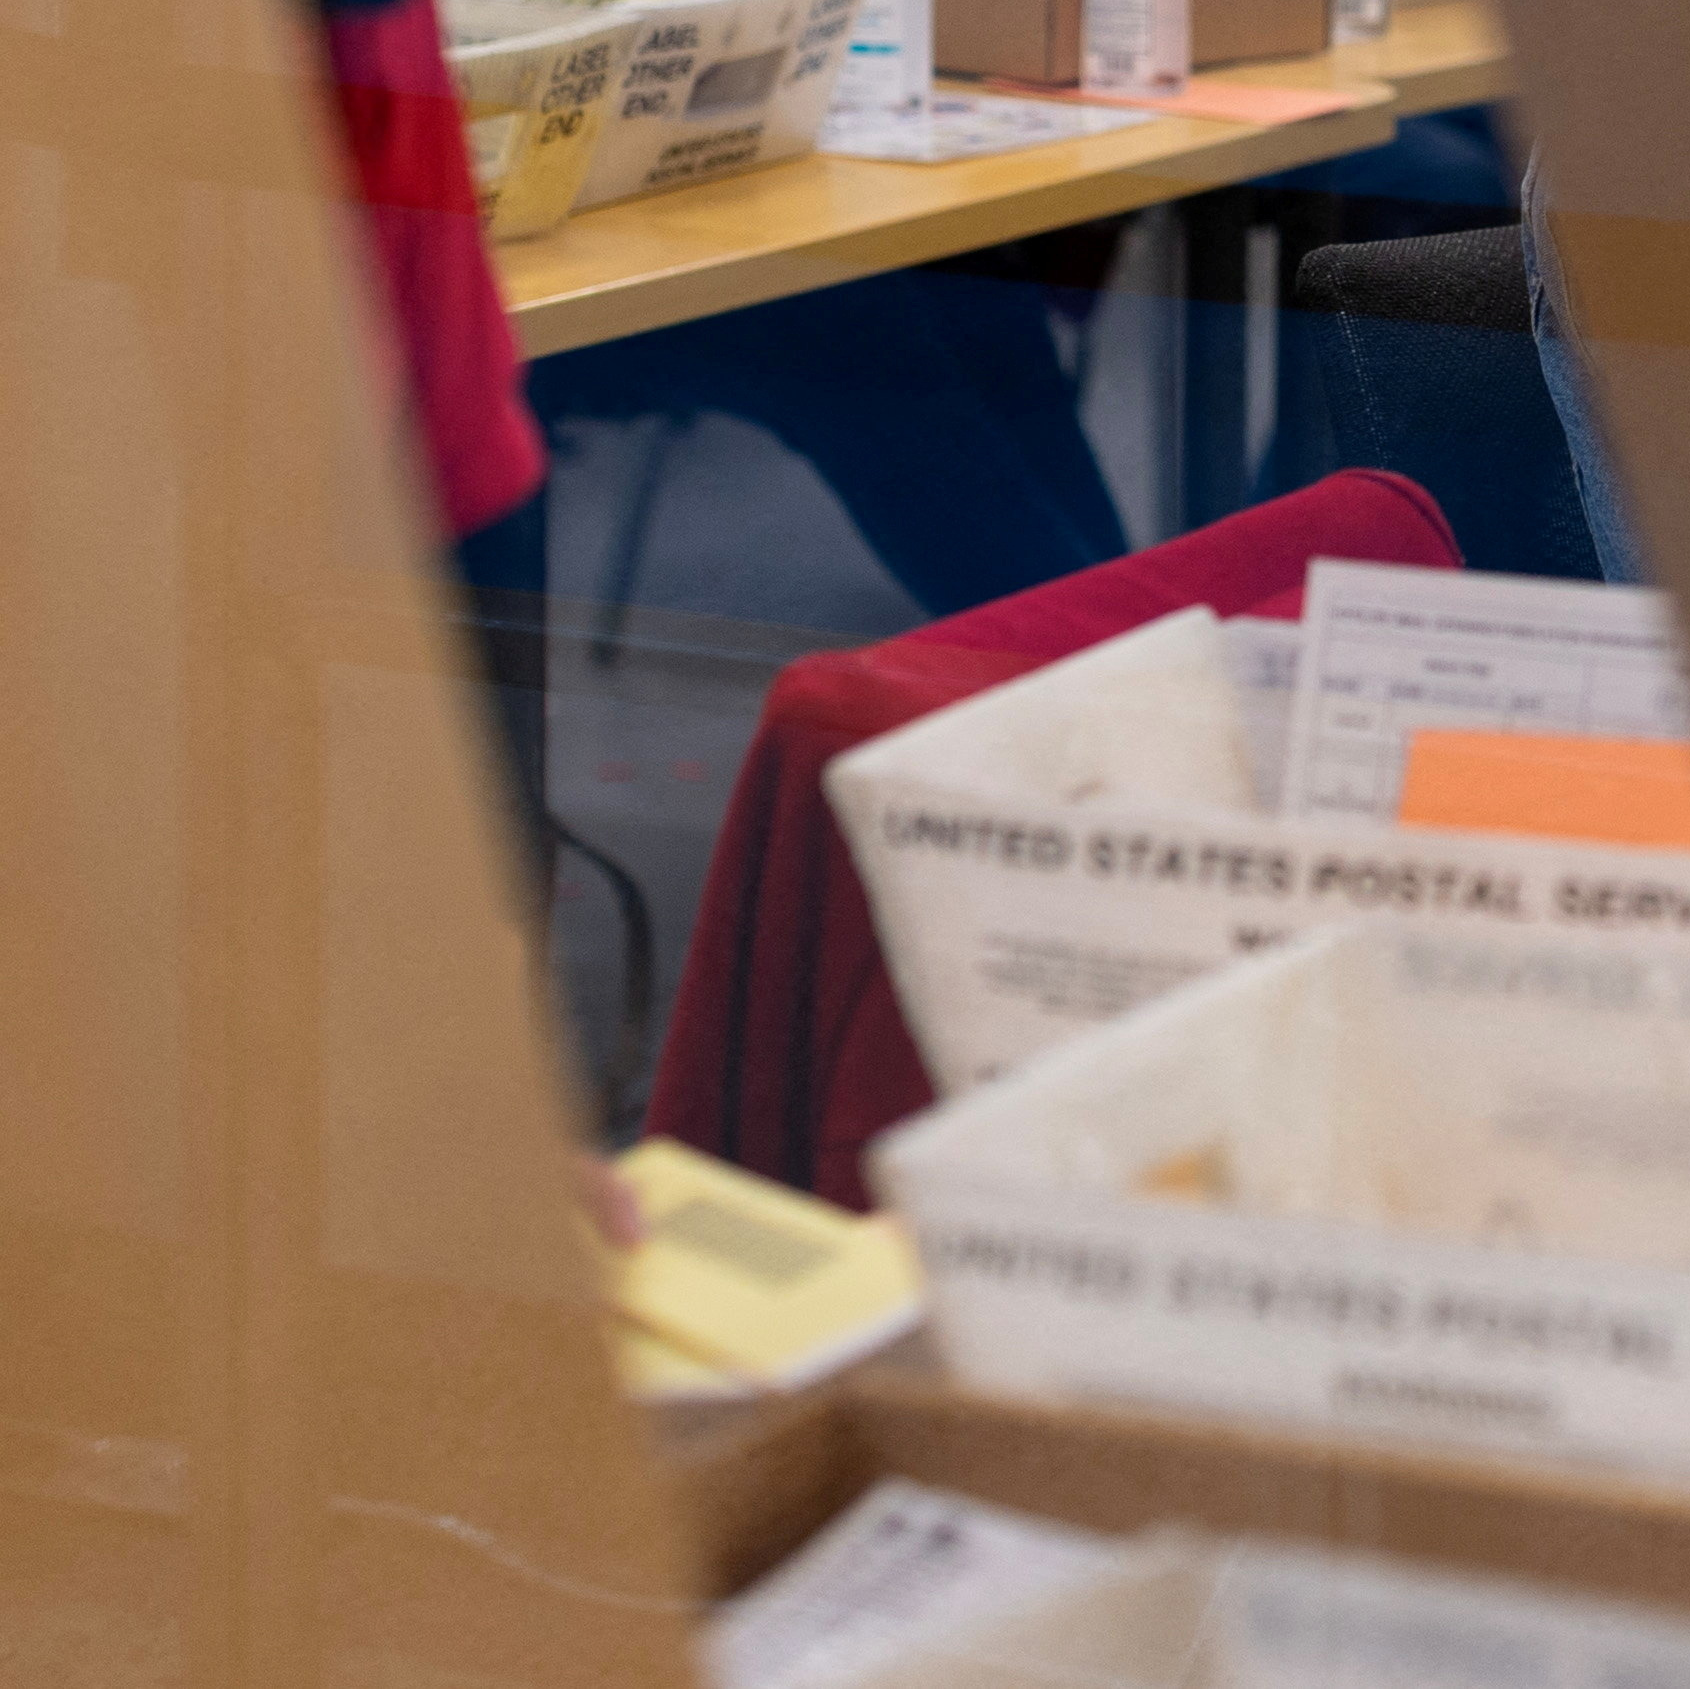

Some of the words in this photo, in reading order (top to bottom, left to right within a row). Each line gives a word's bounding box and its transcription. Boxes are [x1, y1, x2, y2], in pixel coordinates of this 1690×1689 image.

[882, 806, 1074, 874] UNITED
[1086, 826, 1297, 900] STATES
[1310, 852, 1535, 924] POSTAL
